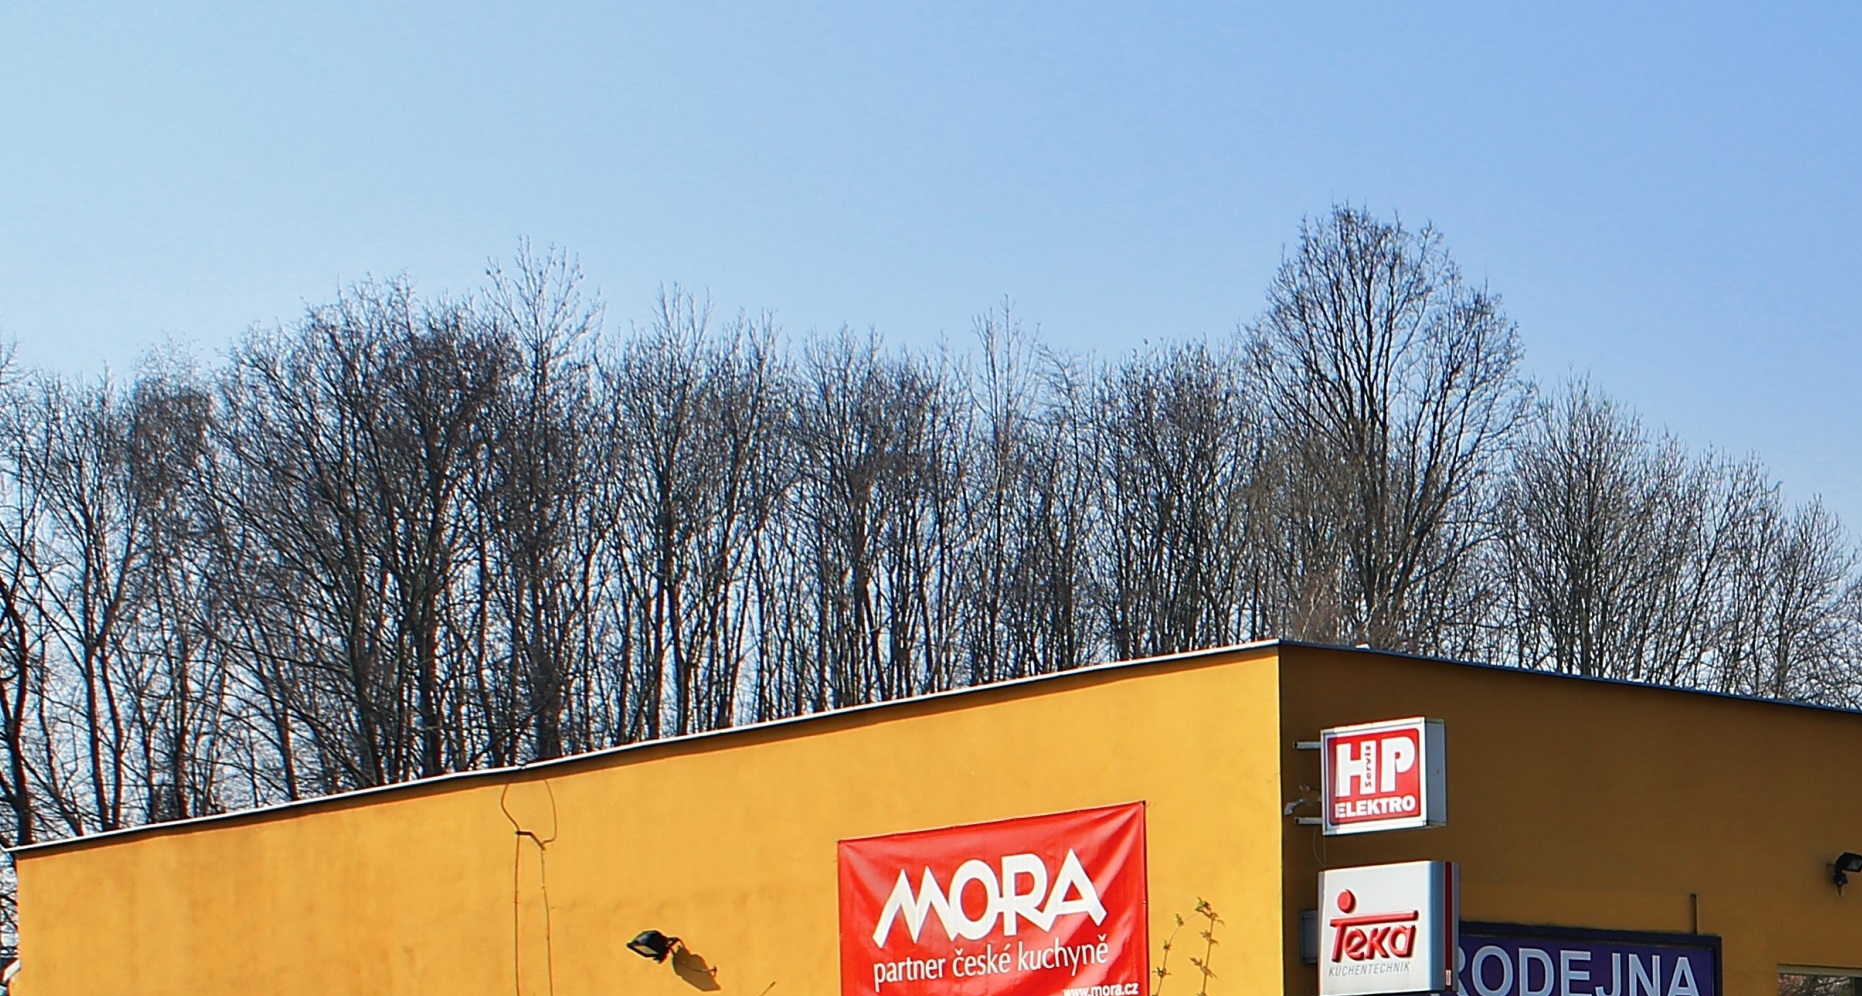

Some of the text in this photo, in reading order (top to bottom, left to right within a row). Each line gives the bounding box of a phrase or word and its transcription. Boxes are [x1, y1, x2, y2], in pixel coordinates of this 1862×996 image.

[1335, 736, 1416, 797] HP
[1364, 745, 1372, 788] Servis
[1335, 795, 1416, 818] ELEKTRO
[872, 848, 1107, 948] MORA
[1330, 905, 1419, 963] Teka
[873, 934, 1109, 993] partner české kuchyně
[1328, 961, 1411, 978] KÜCHENTECHNIK
